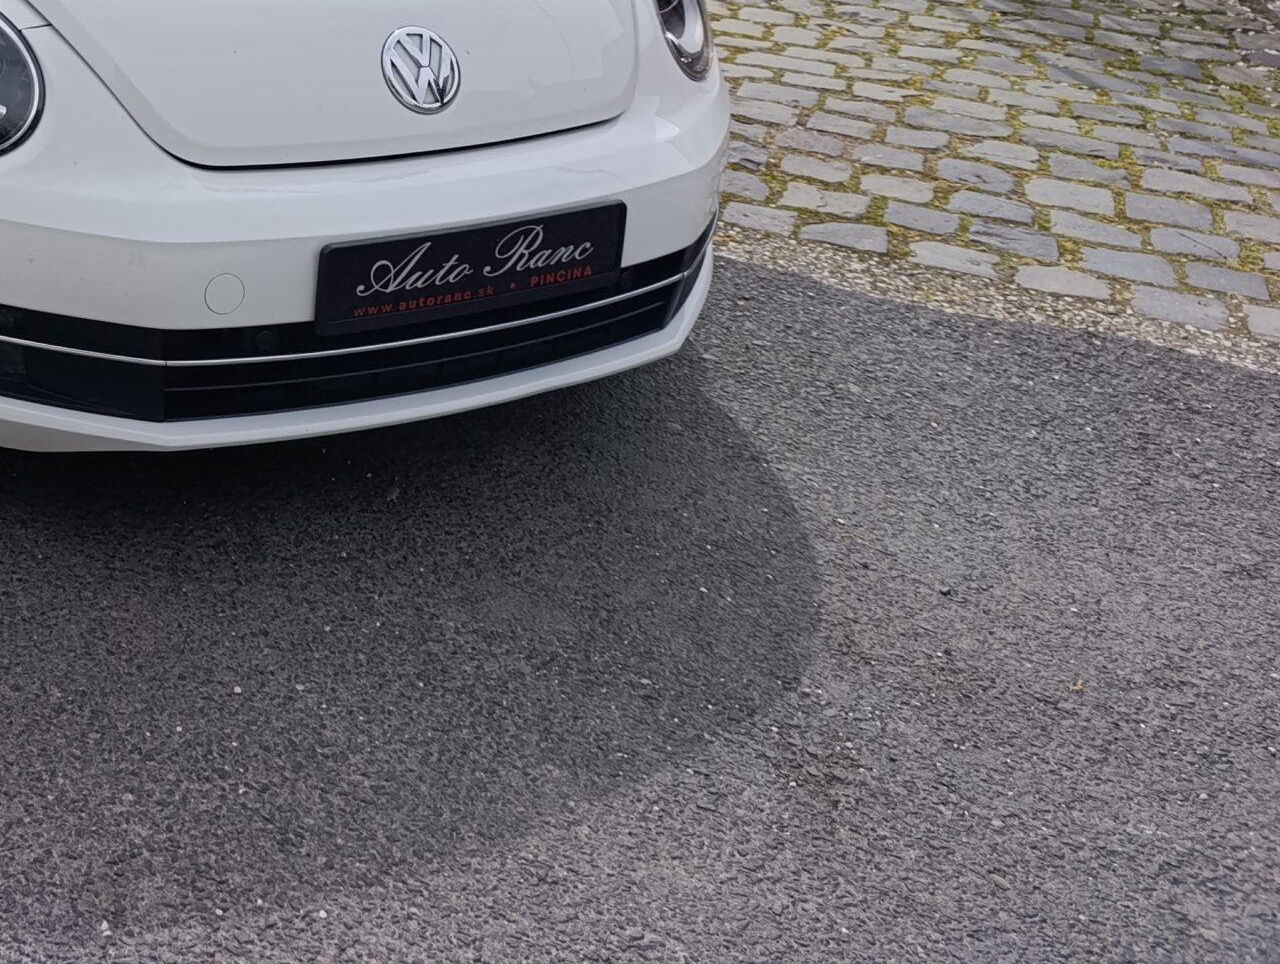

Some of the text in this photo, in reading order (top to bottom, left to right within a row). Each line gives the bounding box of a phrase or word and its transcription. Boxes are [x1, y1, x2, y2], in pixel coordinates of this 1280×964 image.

[353, 264, 593, 317] www.autoranc.sk PINCINA
[355, 223, 595, 297] Auto Ranc
